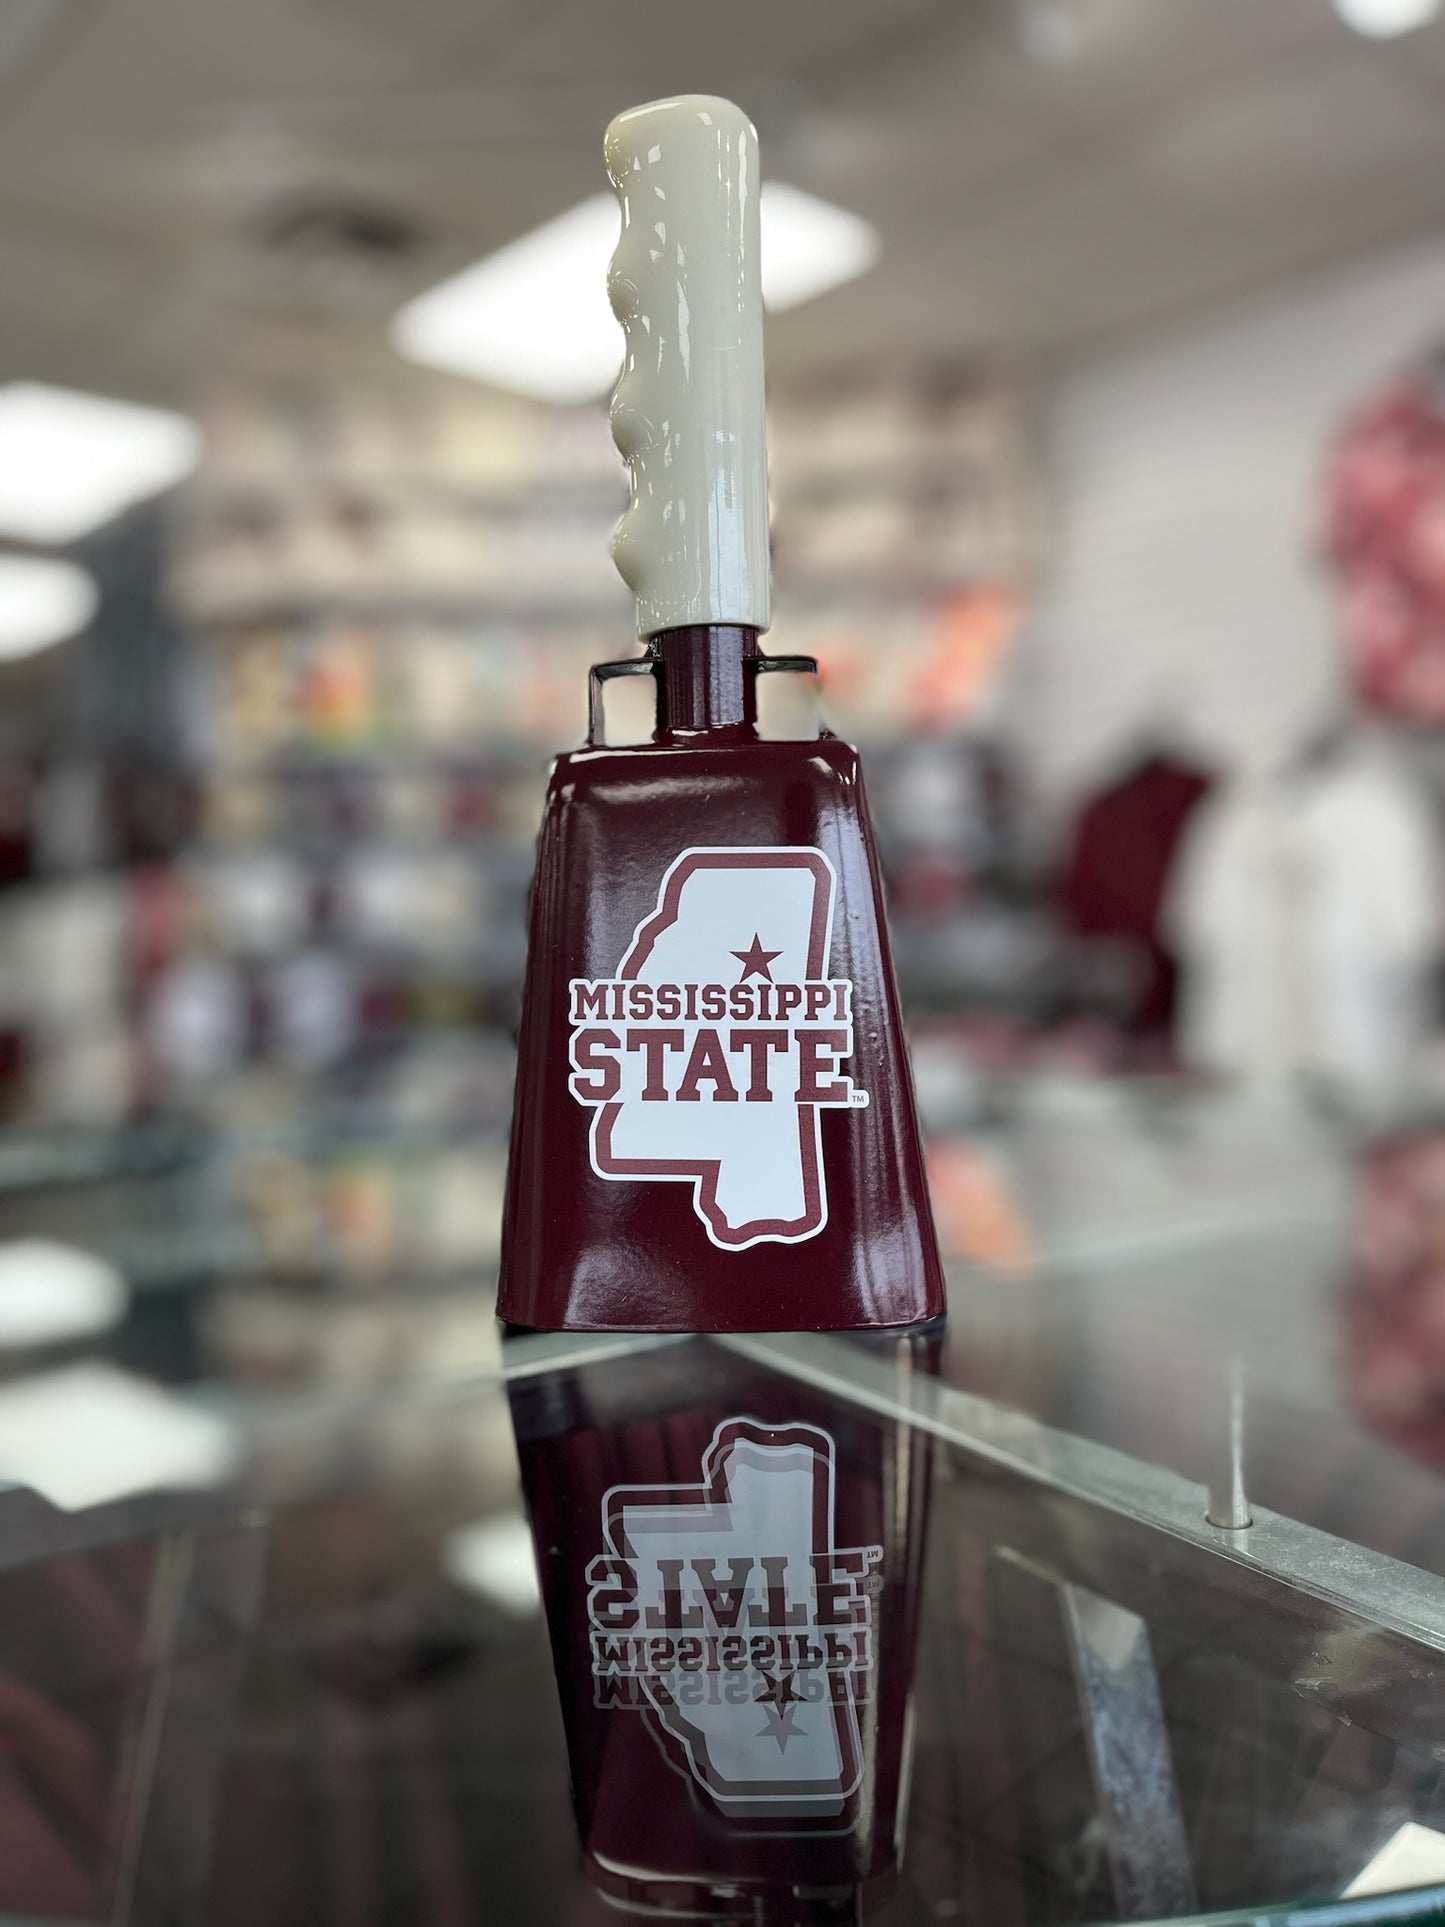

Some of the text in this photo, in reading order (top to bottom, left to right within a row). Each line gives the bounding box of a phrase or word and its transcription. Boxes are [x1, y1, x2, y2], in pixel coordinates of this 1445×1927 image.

[574, 984, 847, 1021] MISSISSIPPI
[574, 1028, 864, 1103] STATE TM
